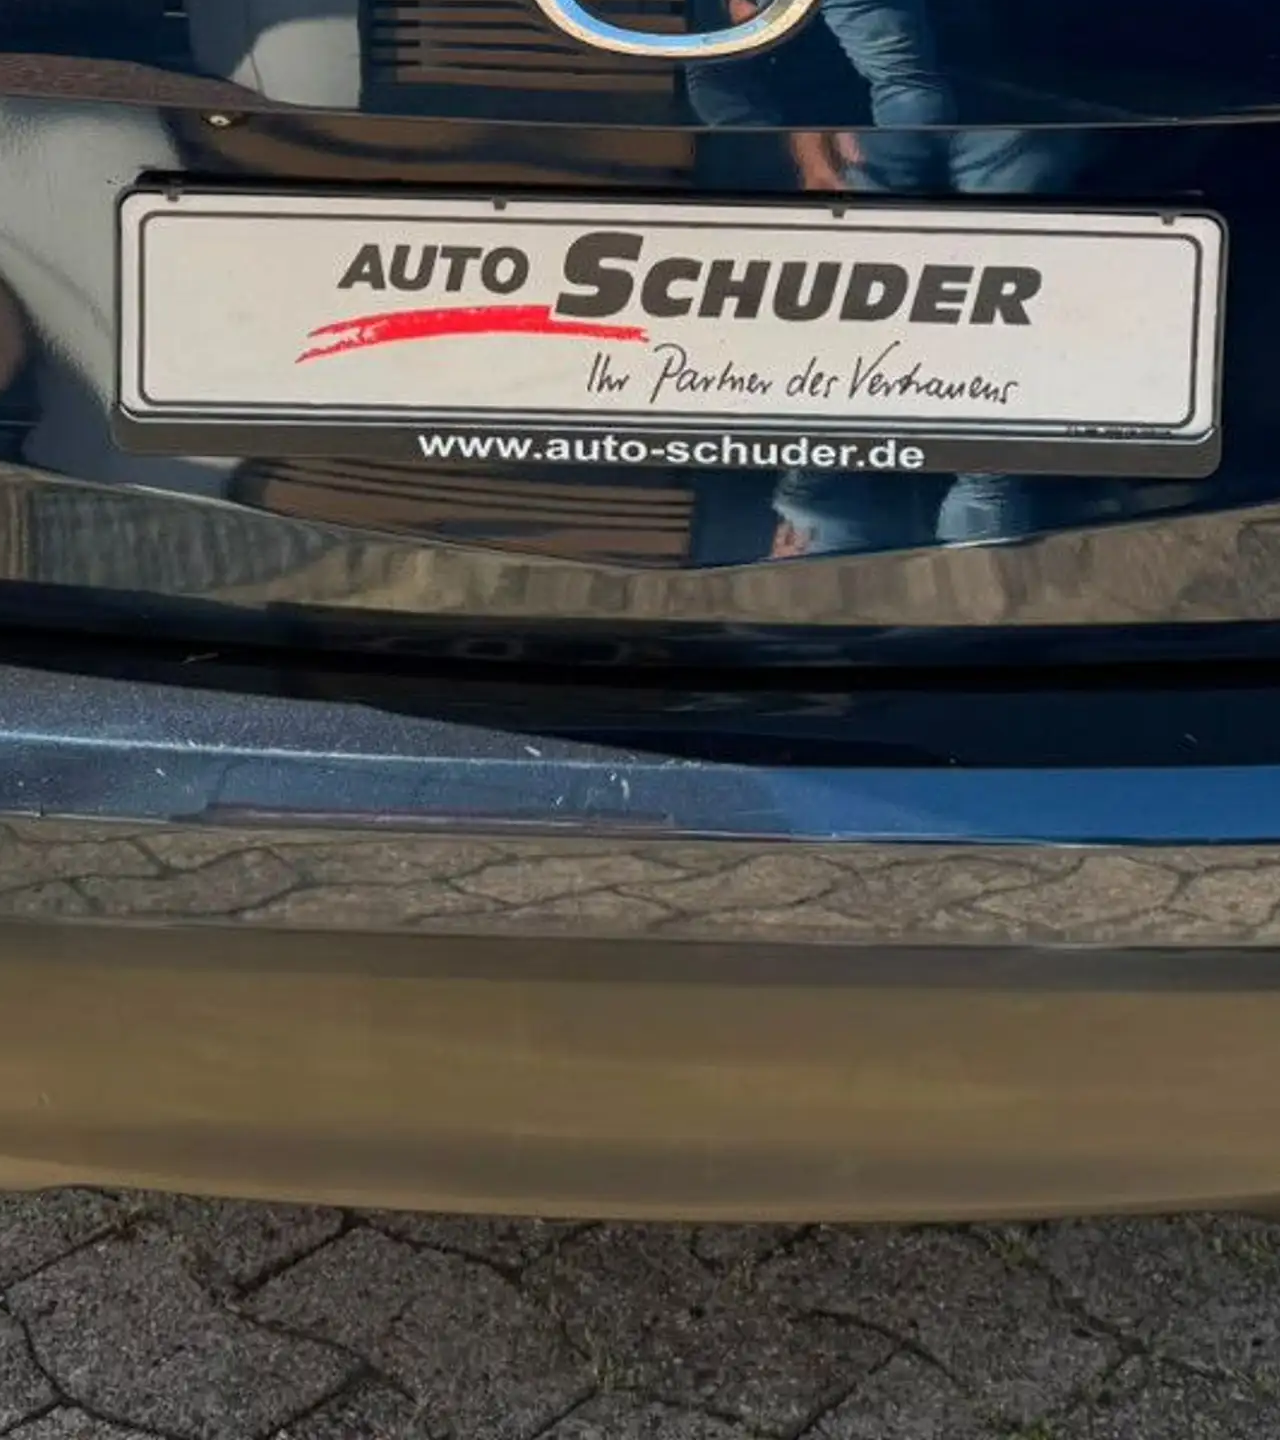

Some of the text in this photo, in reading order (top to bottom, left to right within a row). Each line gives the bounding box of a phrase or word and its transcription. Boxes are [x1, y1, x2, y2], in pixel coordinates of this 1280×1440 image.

[338, 231, 1044, 325] AUTO SCHUDER
[586, 340, 1019, 405] Ihr Partner des Vertrauens
[418, 430, 927, 470] www.auto-schuder.de
